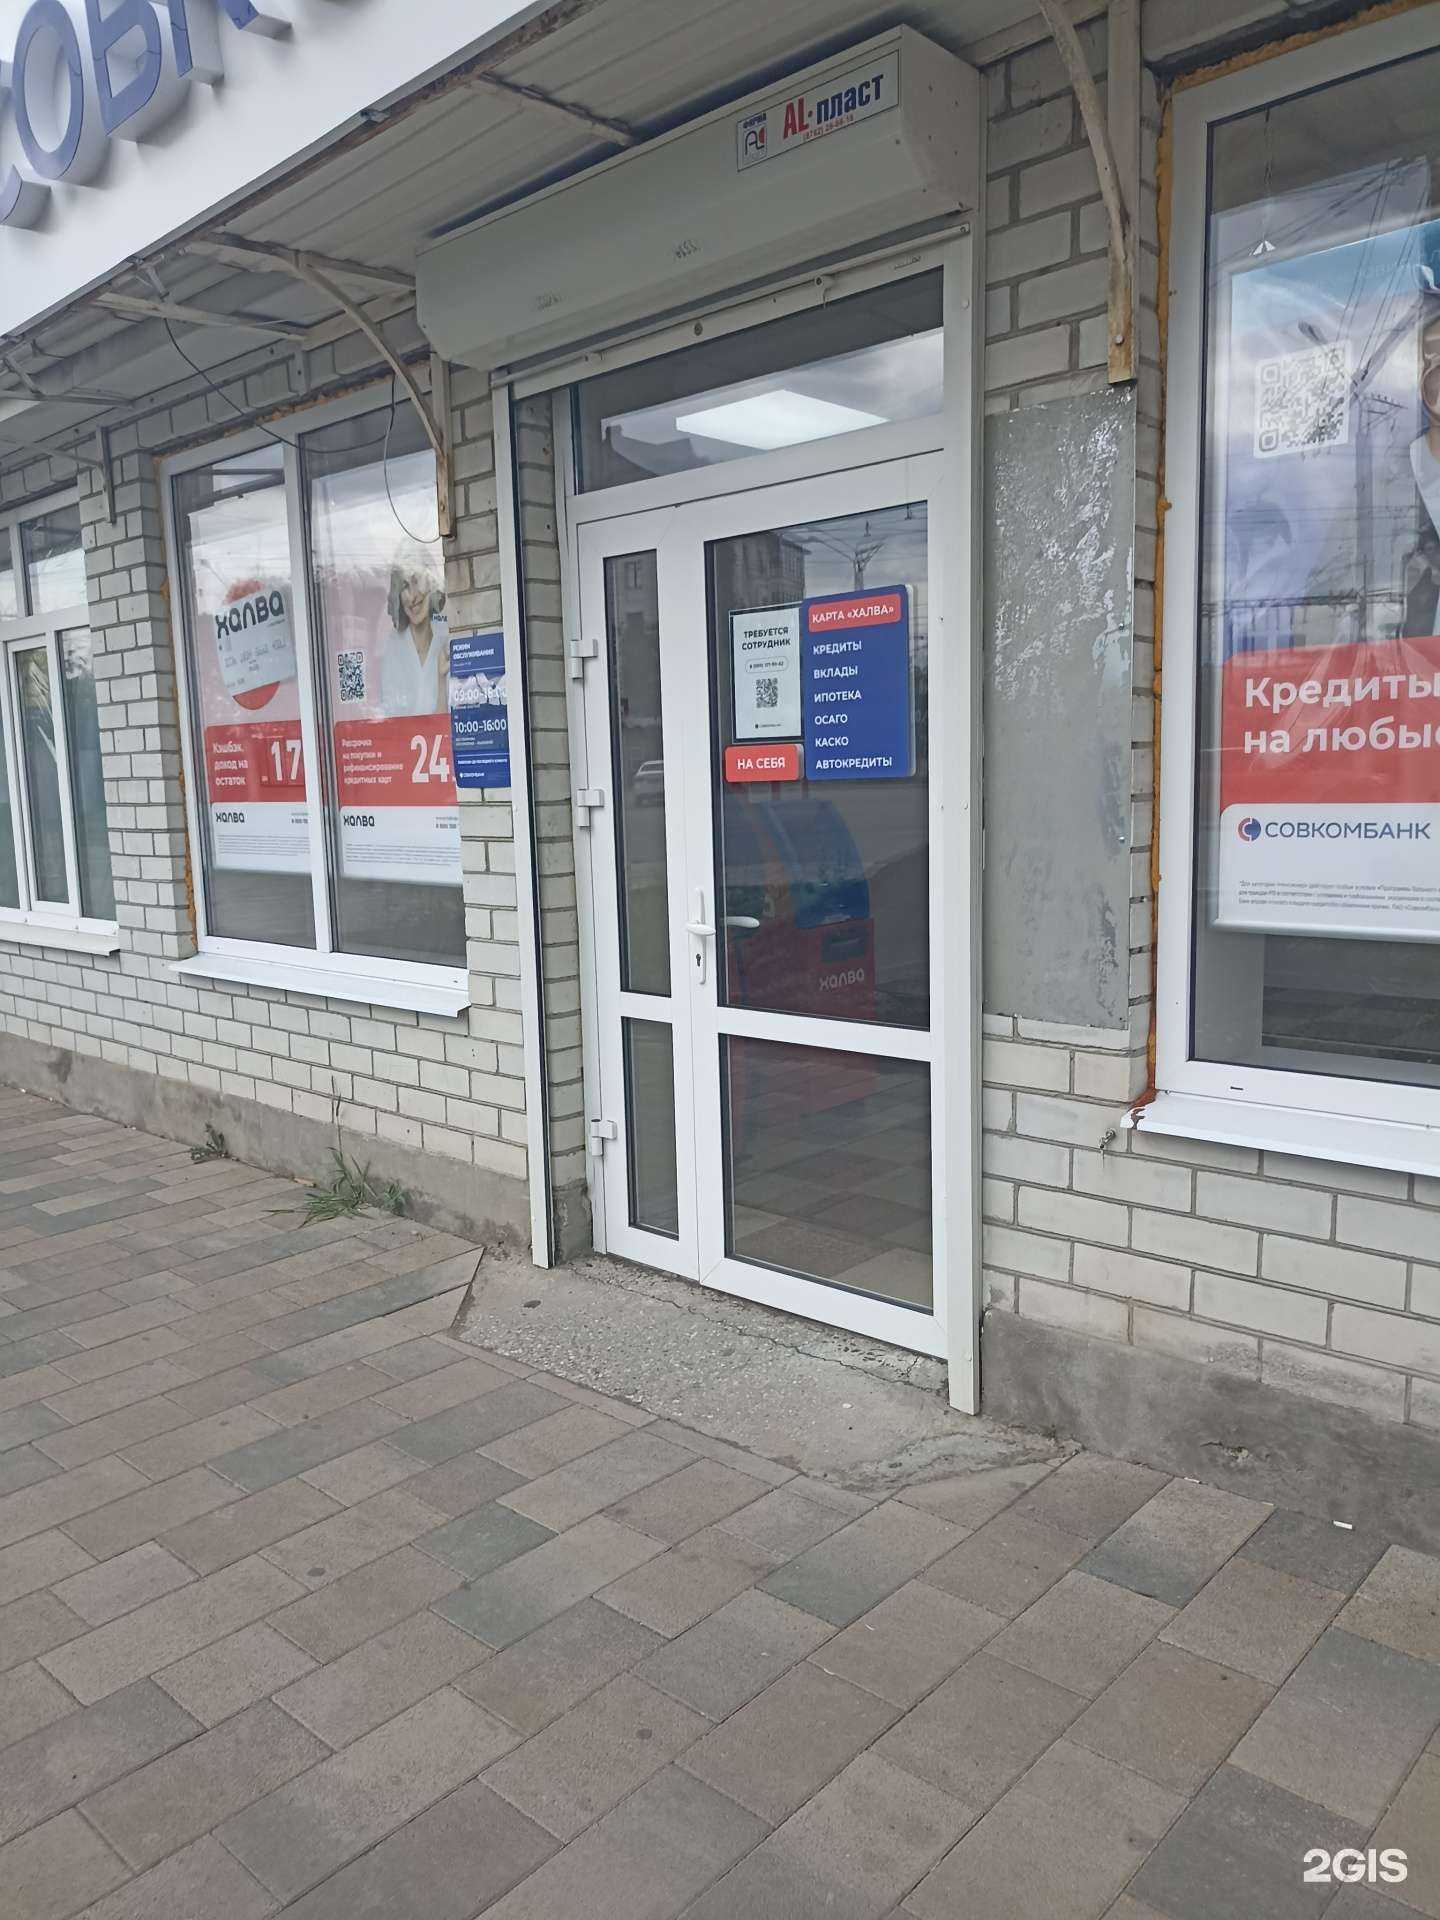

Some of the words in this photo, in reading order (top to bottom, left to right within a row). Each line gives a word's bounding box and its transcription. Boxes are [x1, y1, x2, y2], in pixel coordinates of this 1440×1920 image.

[812, 610, 845, 623] КАРТА
[847, 604, 894, 619] «ХАЛВА»
[743, 626, 789, 638] ТРЕБУЕТСЯ
[742, 638, 791, 650] СОТРУДНИК
[812, 641, 862, 655] КРЕДИТЫ
[813, 665, 858, 679] ВКЛАДЫ
[814, 689, 862, 702] ИПОТЕКА
[1245, 673, 1440, 714] Кредиты
[814, 713, 848, 725] ОСАГО
[815, 736, 849, 747] КАСКО
[1244, 728, 1291, 754] на
[1303, 715, 1440, 752] любы
[410, 734, 450, 783] 24
[737, 758, 754, 769] НА
[756, 757, 786, 769] СЕБЯ
[815, 756, 892, 770] АВТОКРЕДИТЫ
[215, 776, 247, 786] остаток
[1265, 821, 1431, 840] СОВКОМБАНК
